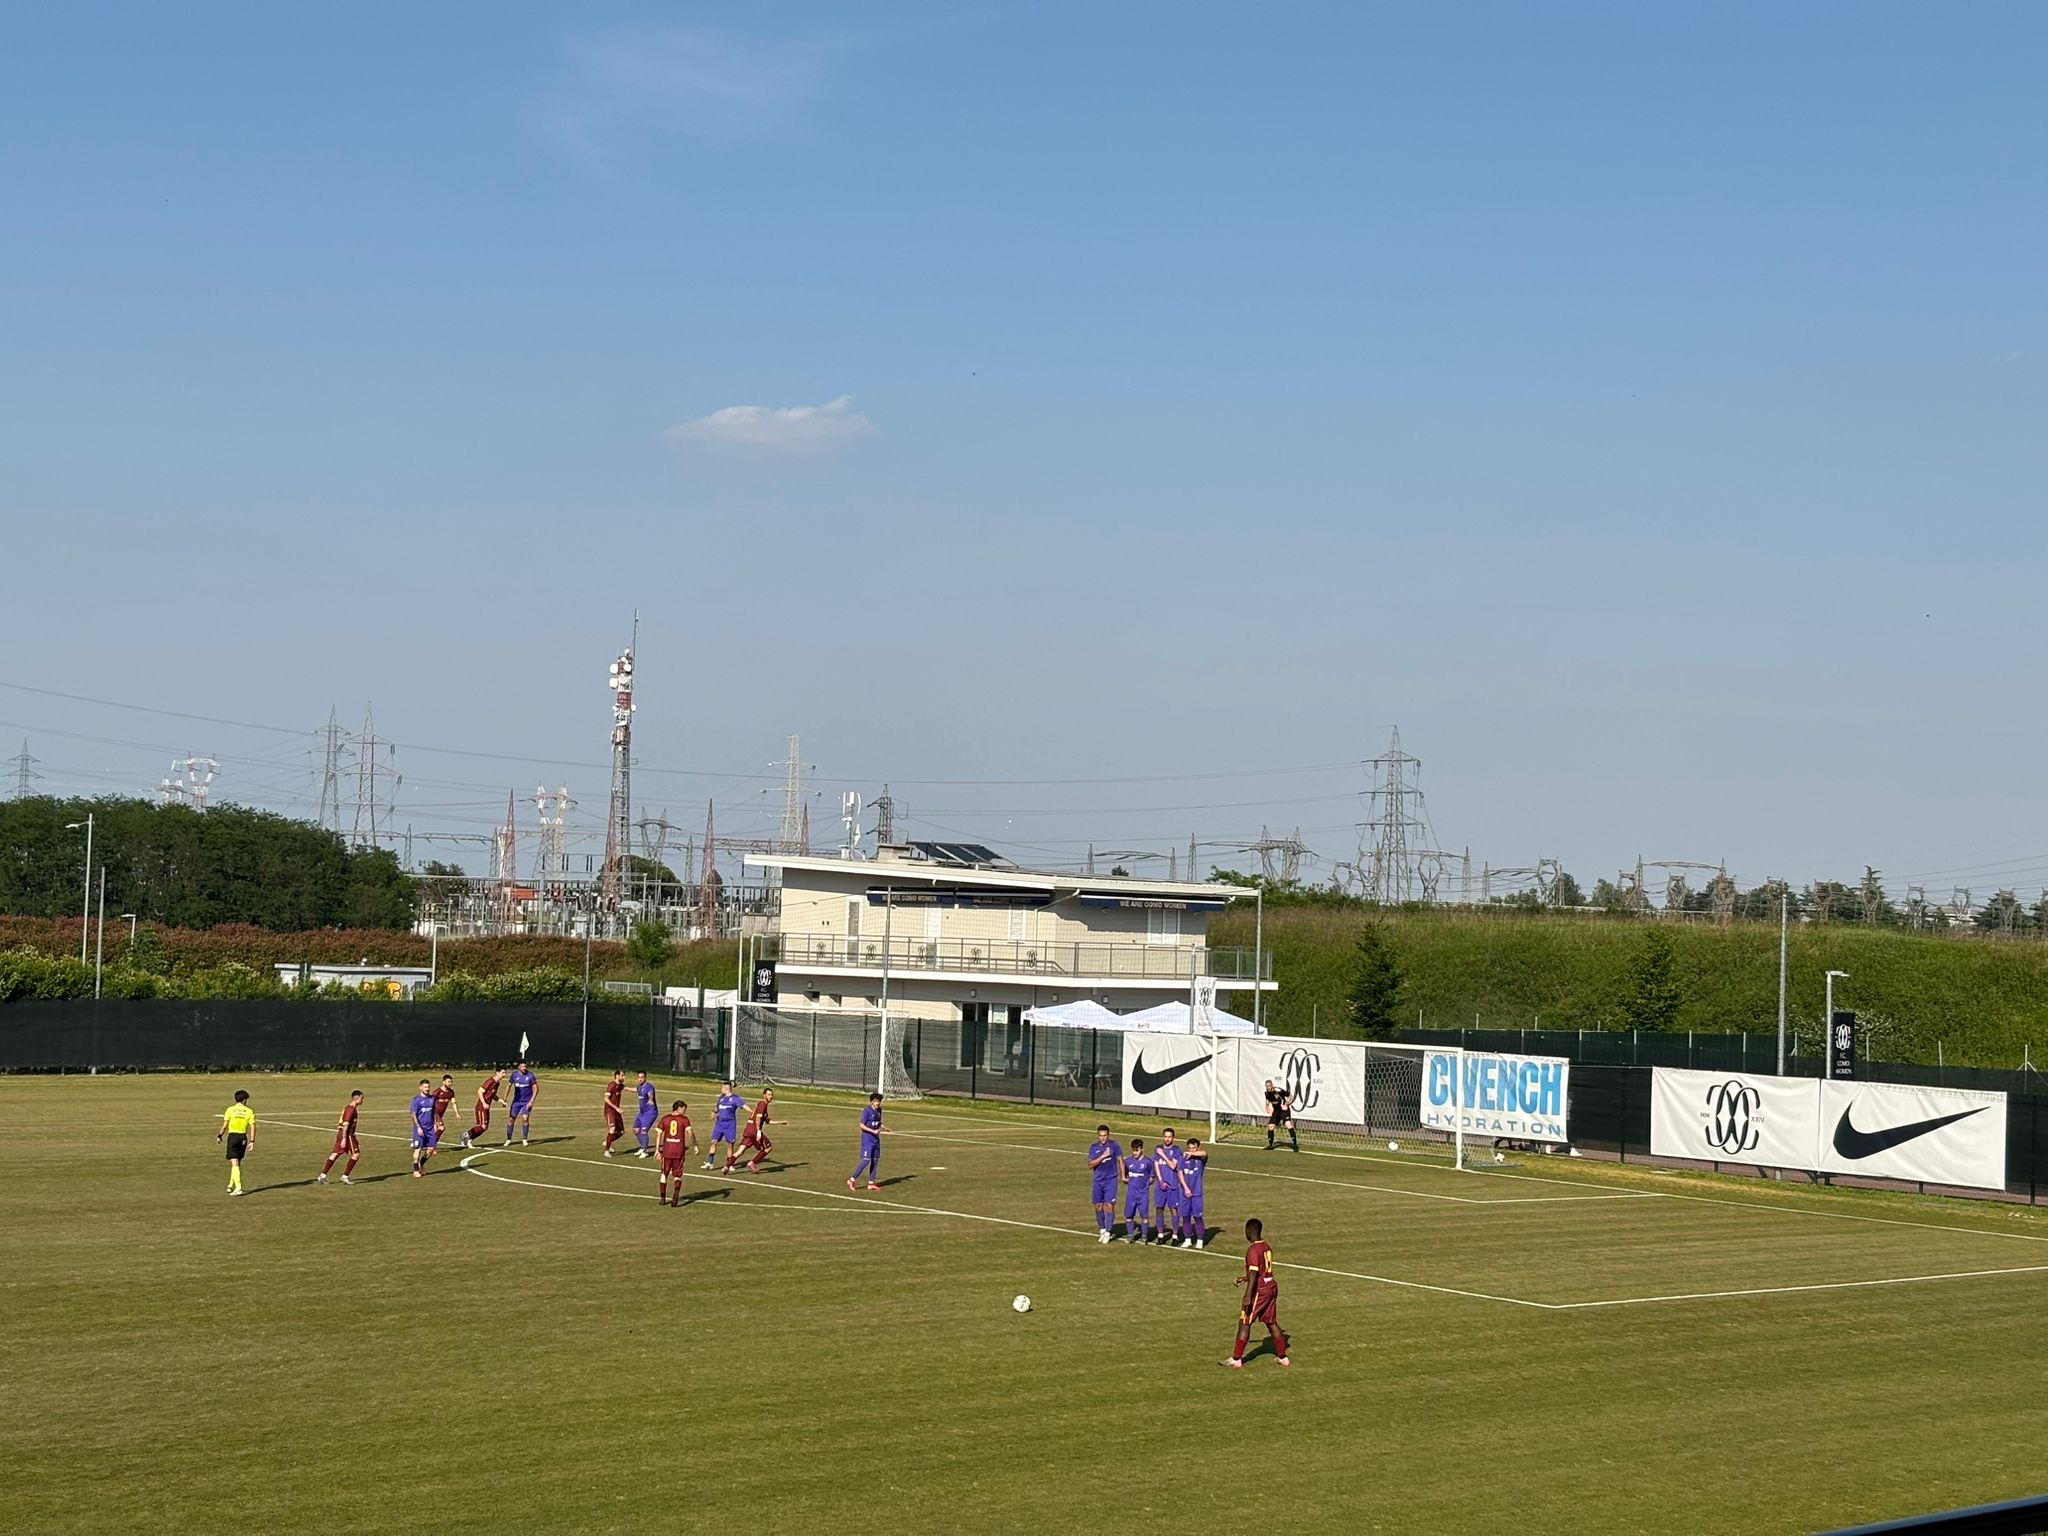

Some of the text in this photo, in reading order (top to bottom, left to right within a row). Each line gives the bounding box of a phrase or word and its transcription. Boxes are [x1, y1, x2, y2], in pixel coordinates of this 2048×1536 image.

[1428, 1054, 1562, 1116] CWENCH
[670, 1120, 678, 1136] 8
[1427, 1113, 1562, 1136] HYDRATION
